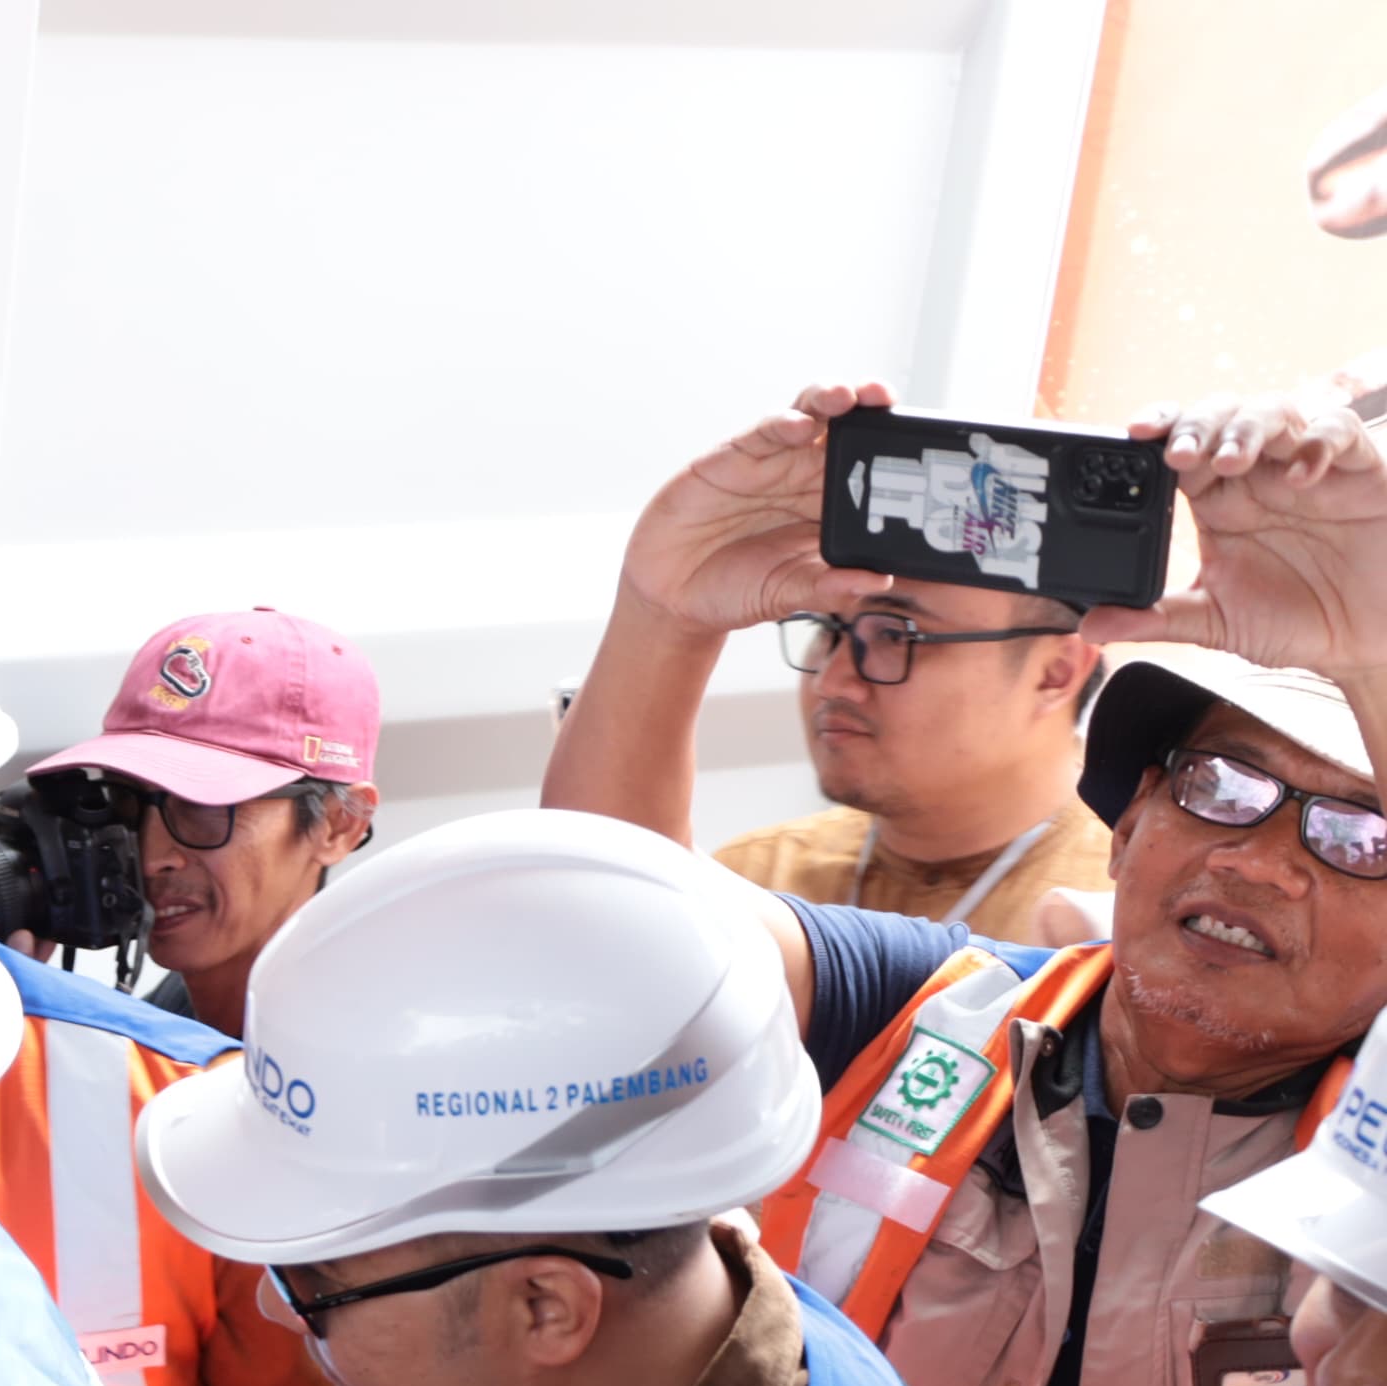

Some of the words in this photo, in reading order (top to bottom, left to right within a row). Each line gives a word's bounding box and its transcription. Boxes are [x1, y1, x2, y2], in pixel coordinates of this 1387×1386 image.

[961, 510, 988, 556] AIR
[992, 476, 1020, 541] NIKE
[416, 1090, 538, 1117] REGIONAL
[546, 1086, 559, 1111] 2
[566, 1057, 708, 1108] PALEMBANG
[1338, 1088, 1387, 1158] PE
